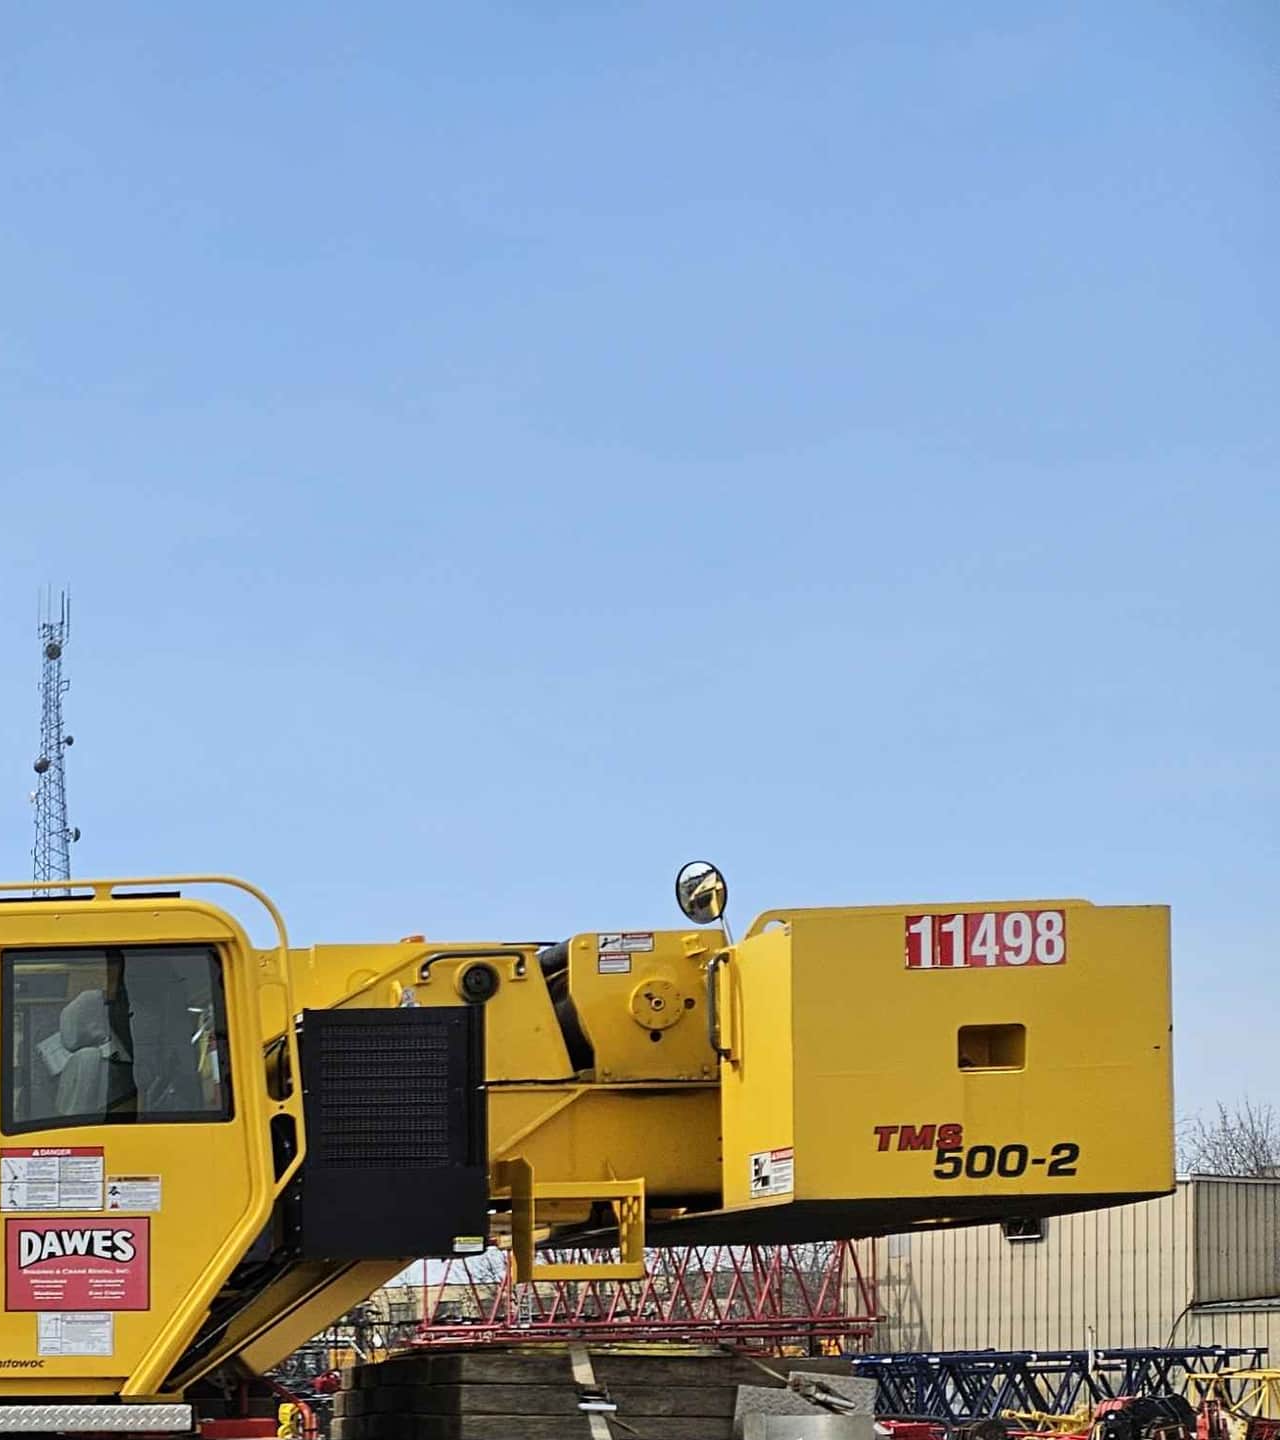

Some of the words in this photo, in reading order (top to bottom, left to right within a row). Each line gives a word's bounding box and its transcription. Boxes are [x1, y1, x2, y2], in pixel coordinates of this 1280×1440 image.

[909, 911, 1065, 968] 11498
[874, 1123, 964, 1151] TMS
[933, 1143, 1080, 1179] 500-2
[19, 1230, 135, 1269] DAWES
